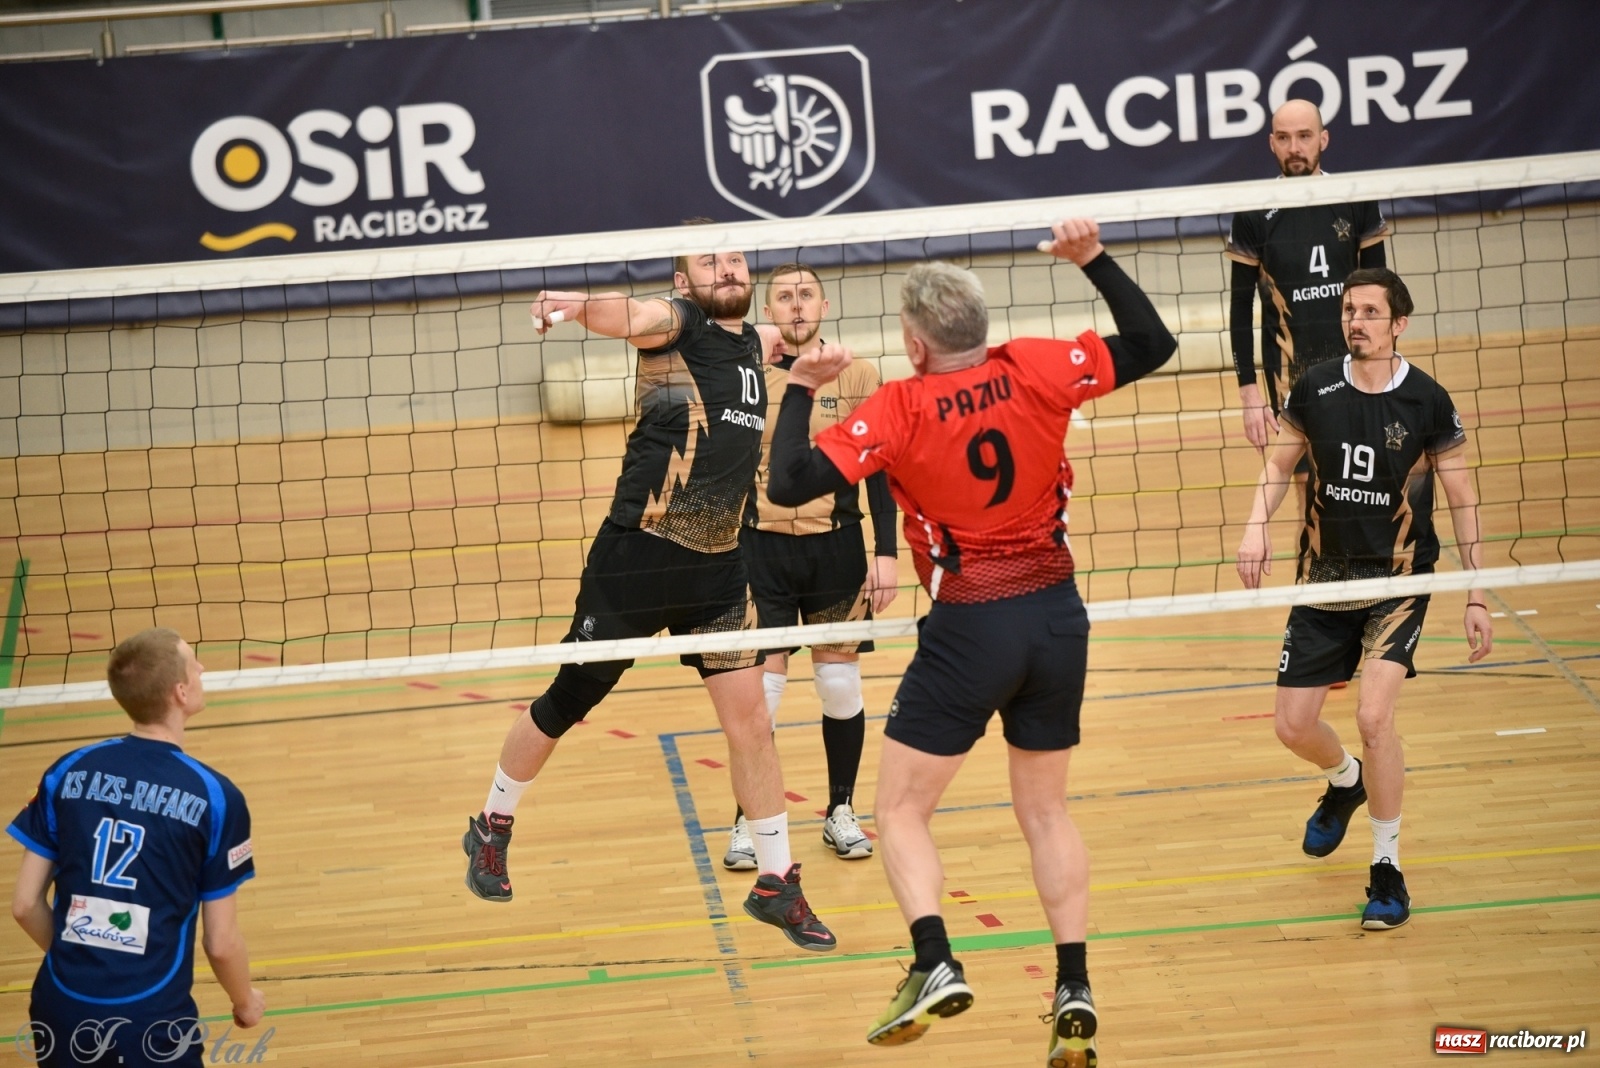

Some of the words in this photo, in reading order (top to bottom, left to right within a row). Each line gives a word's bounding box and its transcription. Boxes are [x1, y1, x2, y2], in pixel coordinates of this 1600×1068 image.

[970, 36, 1473, 161] RACIBÓRZ
[313, 200, 489, 243] RACIBÓRZ
[1309, 245, 1330, 278] 4
[737, 365, 760, 406] 10
[936, 375, 1012, 422] PAZIU
[966, 427, 1015, 510] 9
[1340, 442, 1376, 482] 19
[1325, 483, 1391, 507] AGROTIM
[61, 770, 87, 799] KS
[85, 771, 208, 827] AZS-RAFAKO
[91, 817, 146, 890] 12
